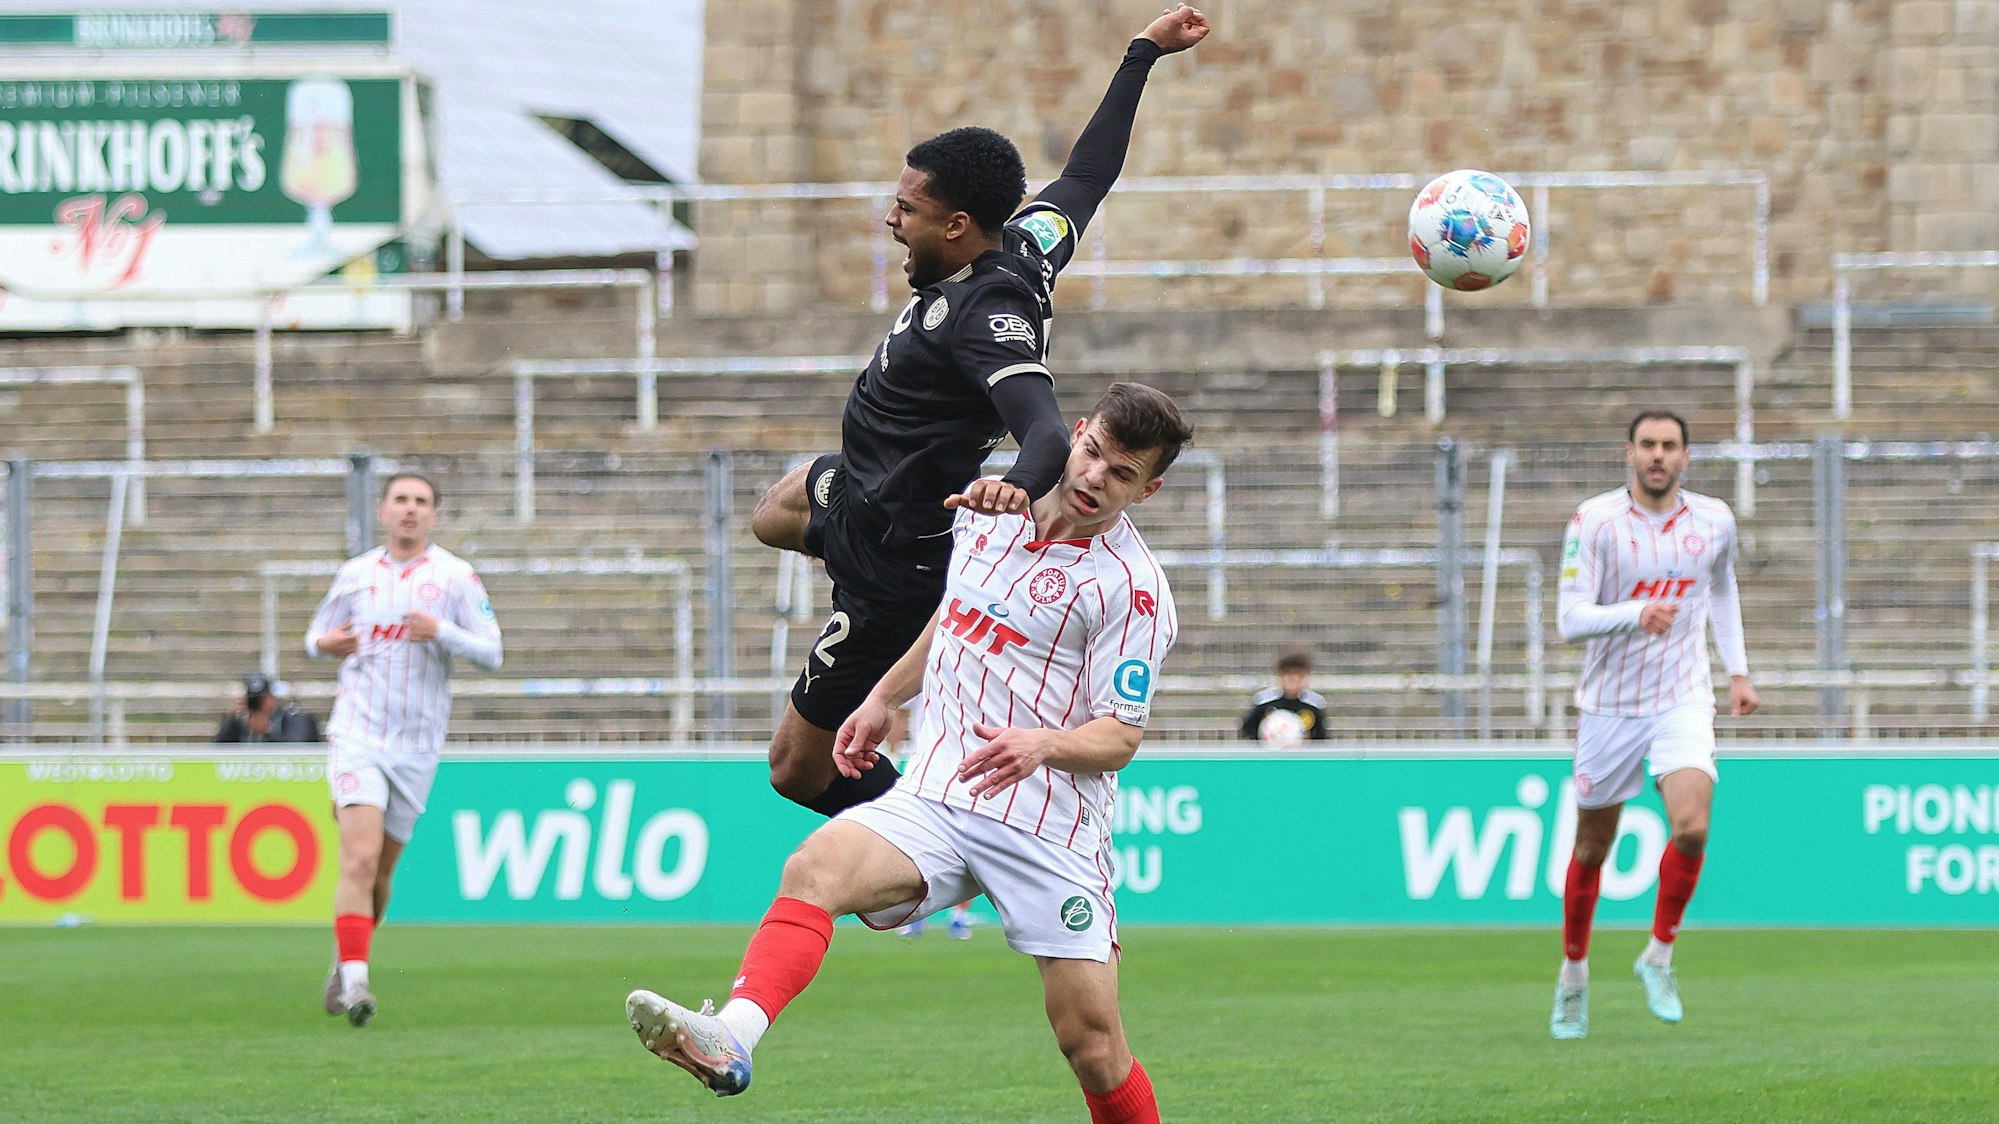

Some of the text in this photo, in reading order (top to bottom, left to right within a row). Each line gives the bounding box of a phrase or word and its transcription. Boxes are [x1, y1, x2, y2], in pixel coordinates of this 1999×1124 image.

[105, 80, 241, 108] PILSENER
[989, 317, 1036, 339] OBO
[1629, 578, 1698, 601] HIT
[369, 623, 407, 643] HI
[940, 597, 1030, 656] HIT
[1863, 783, 1999, 835] PION
[0, 804, 320, 903] OTTO
[452, 776, 710, 901] wilo
[1399, 775, 1668, 901] wilo
[1905, 843, 1999, 895] FOR
